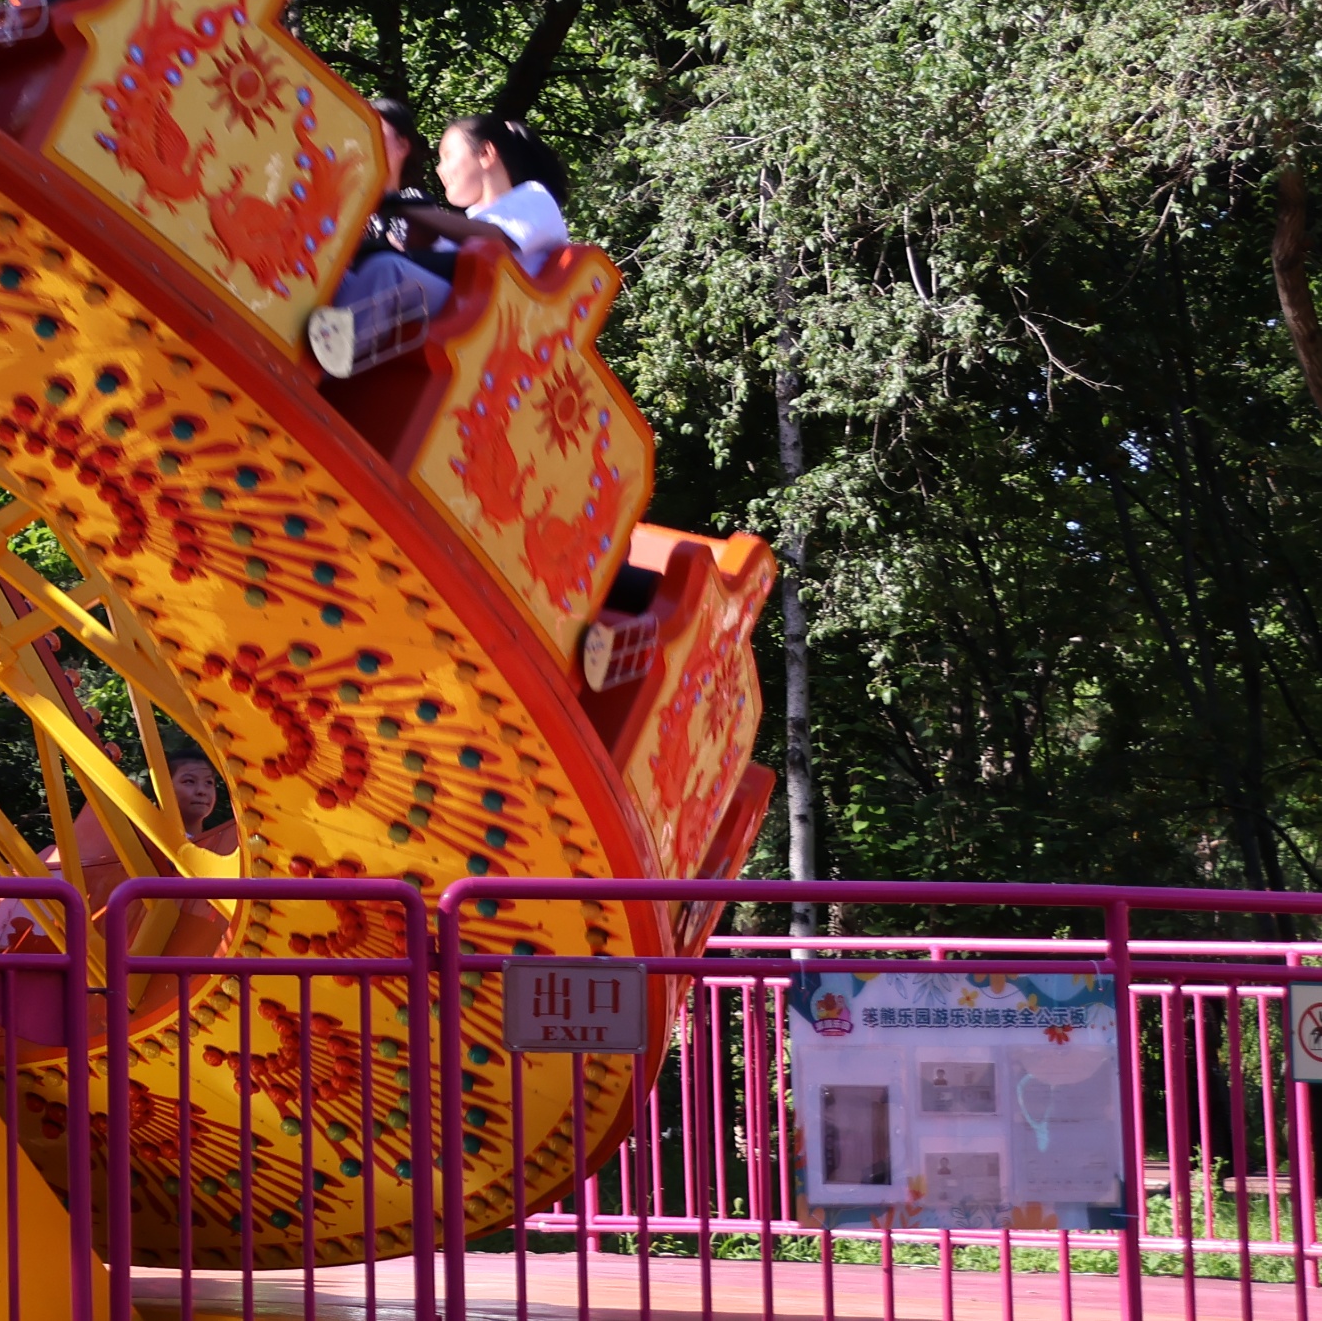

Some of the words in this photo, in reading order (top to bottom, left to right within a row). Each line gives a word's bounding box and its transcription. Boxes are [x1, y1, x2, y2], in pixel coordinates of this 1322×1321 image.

[533, 972, 620, 1020] 出口
[862, 1007, 1087, 1028] 笨熊乐园游乐设施安全公示板
[541, 1025, 608, 1041] EXIT
